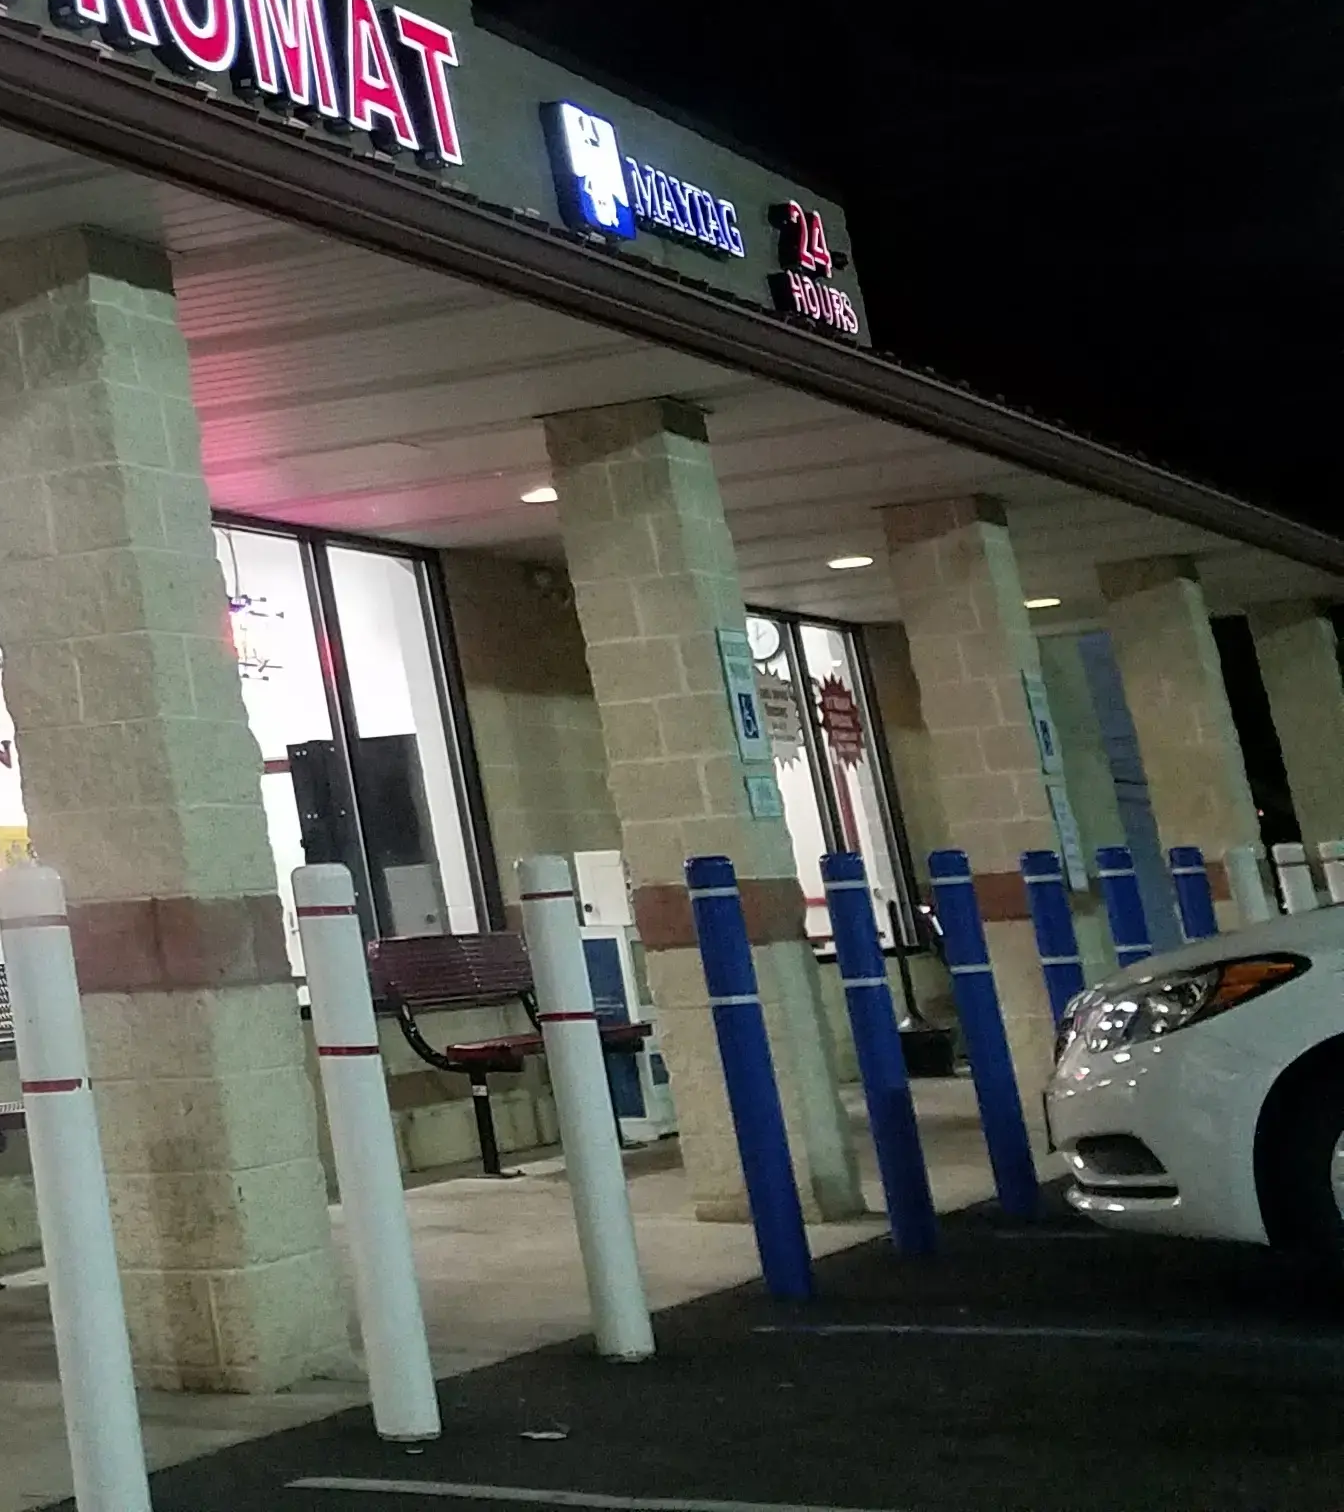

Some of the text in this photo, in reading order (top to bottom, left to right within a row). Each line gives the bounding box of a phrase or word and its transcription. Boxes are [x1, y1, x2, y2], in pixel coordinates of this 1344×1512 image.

[625, 156, 746, 258] MAYTAG
[784, 199, 833, 278] 24
[786, 268, 860, 335] HOURS
